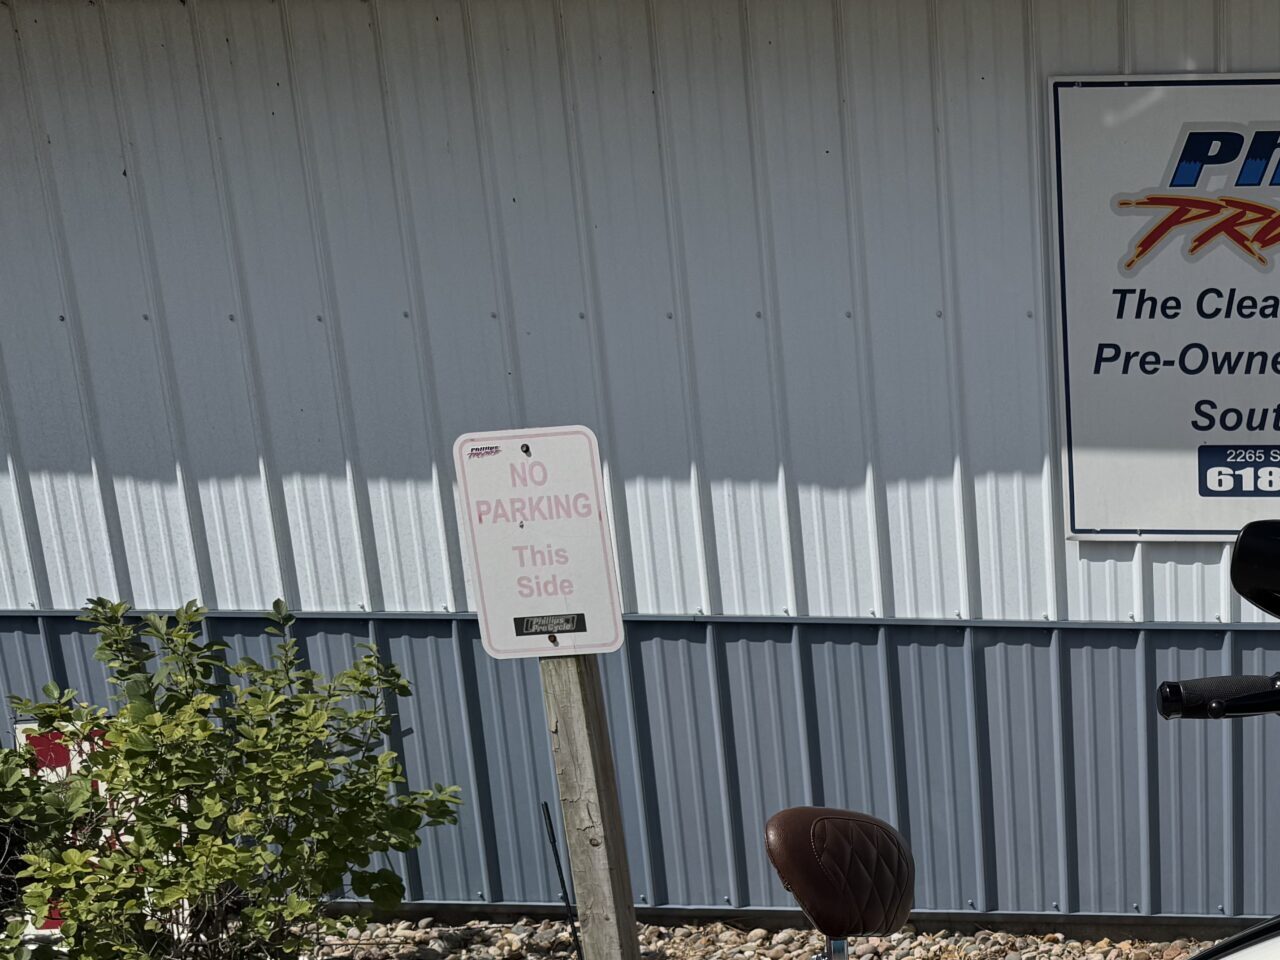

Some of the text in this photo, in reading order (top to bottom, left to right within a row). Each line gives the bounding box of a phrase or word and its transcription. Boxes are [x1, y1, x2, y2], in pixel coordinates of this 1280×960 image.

[1110, 286, 1183, 323] The
[1226, 449, 1265, 462] 2265
[510, 461, 548, 488] NO
[475, 492, 593, 524] PARKING
[512, 545, 569, 567] This
[516, 574, 574, 598] Side
